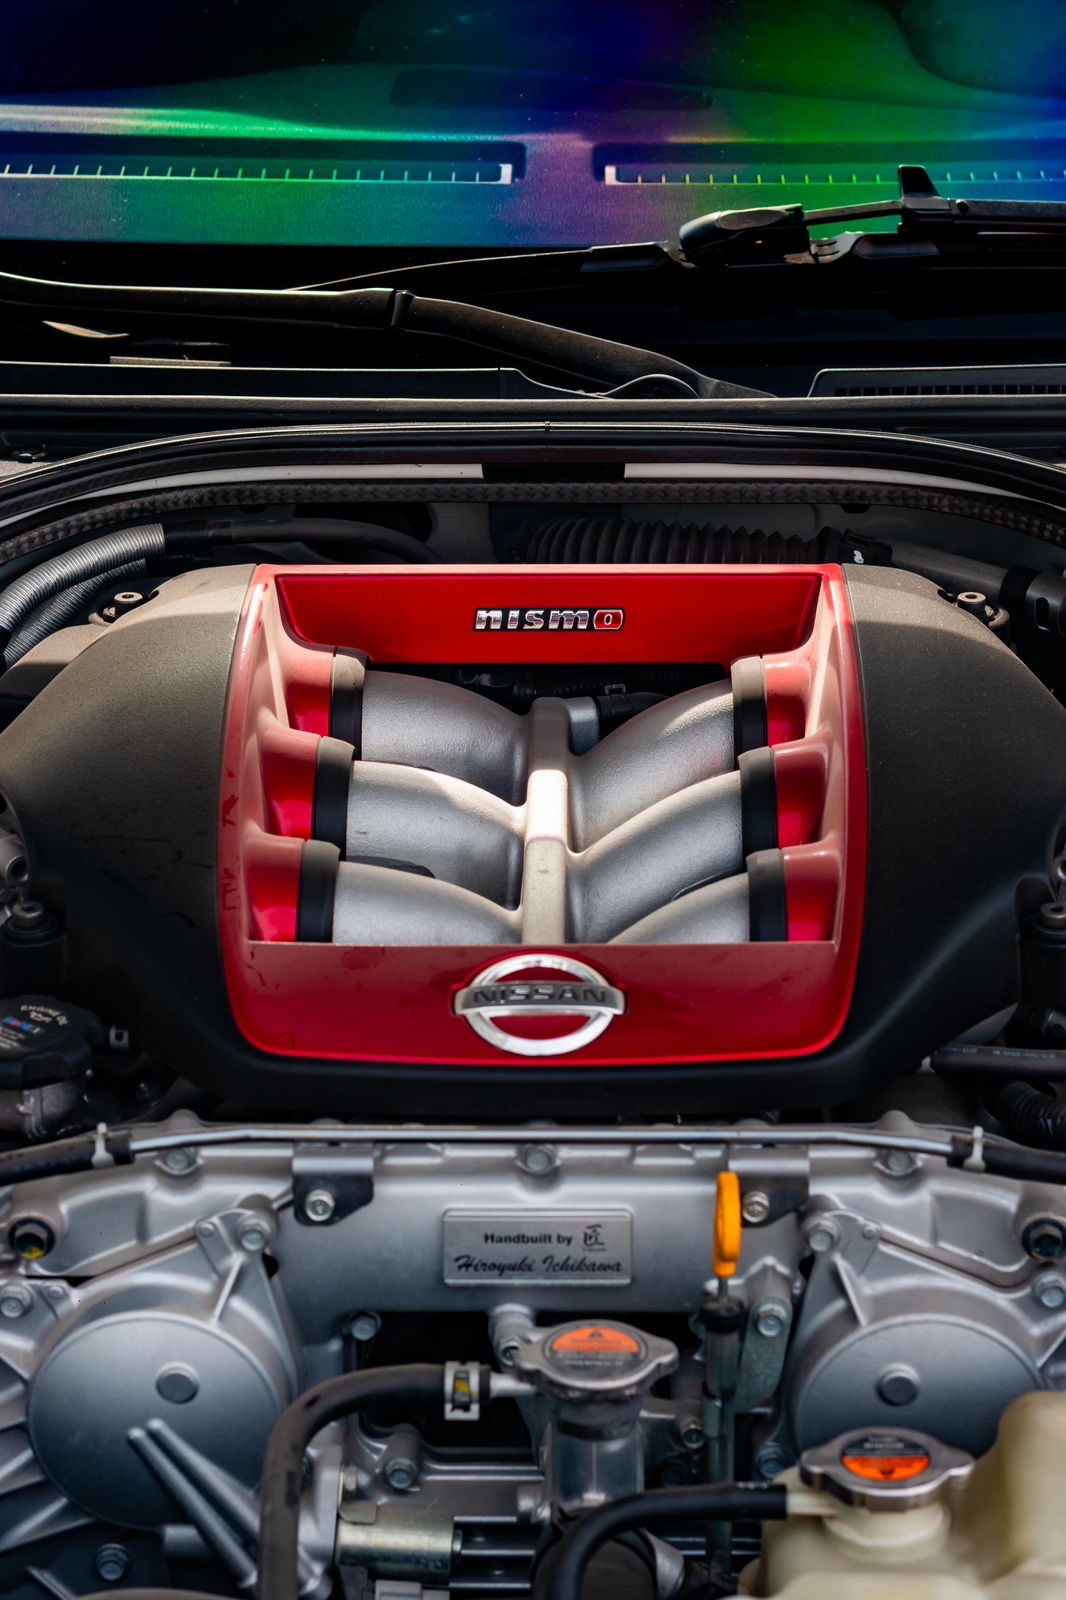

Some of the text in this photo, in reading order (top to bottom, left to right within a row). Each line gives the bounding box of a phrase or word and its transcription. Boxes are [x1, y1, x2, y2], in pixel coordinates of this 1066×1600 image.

[475, 608, 624, 630] nismo
[473, 985, 606, 1003] NISSAN
[484, 1233, 573, 1246] Handbuilt by
[454, 1254, 622, 1277] Hiroyuki Ichikawa
